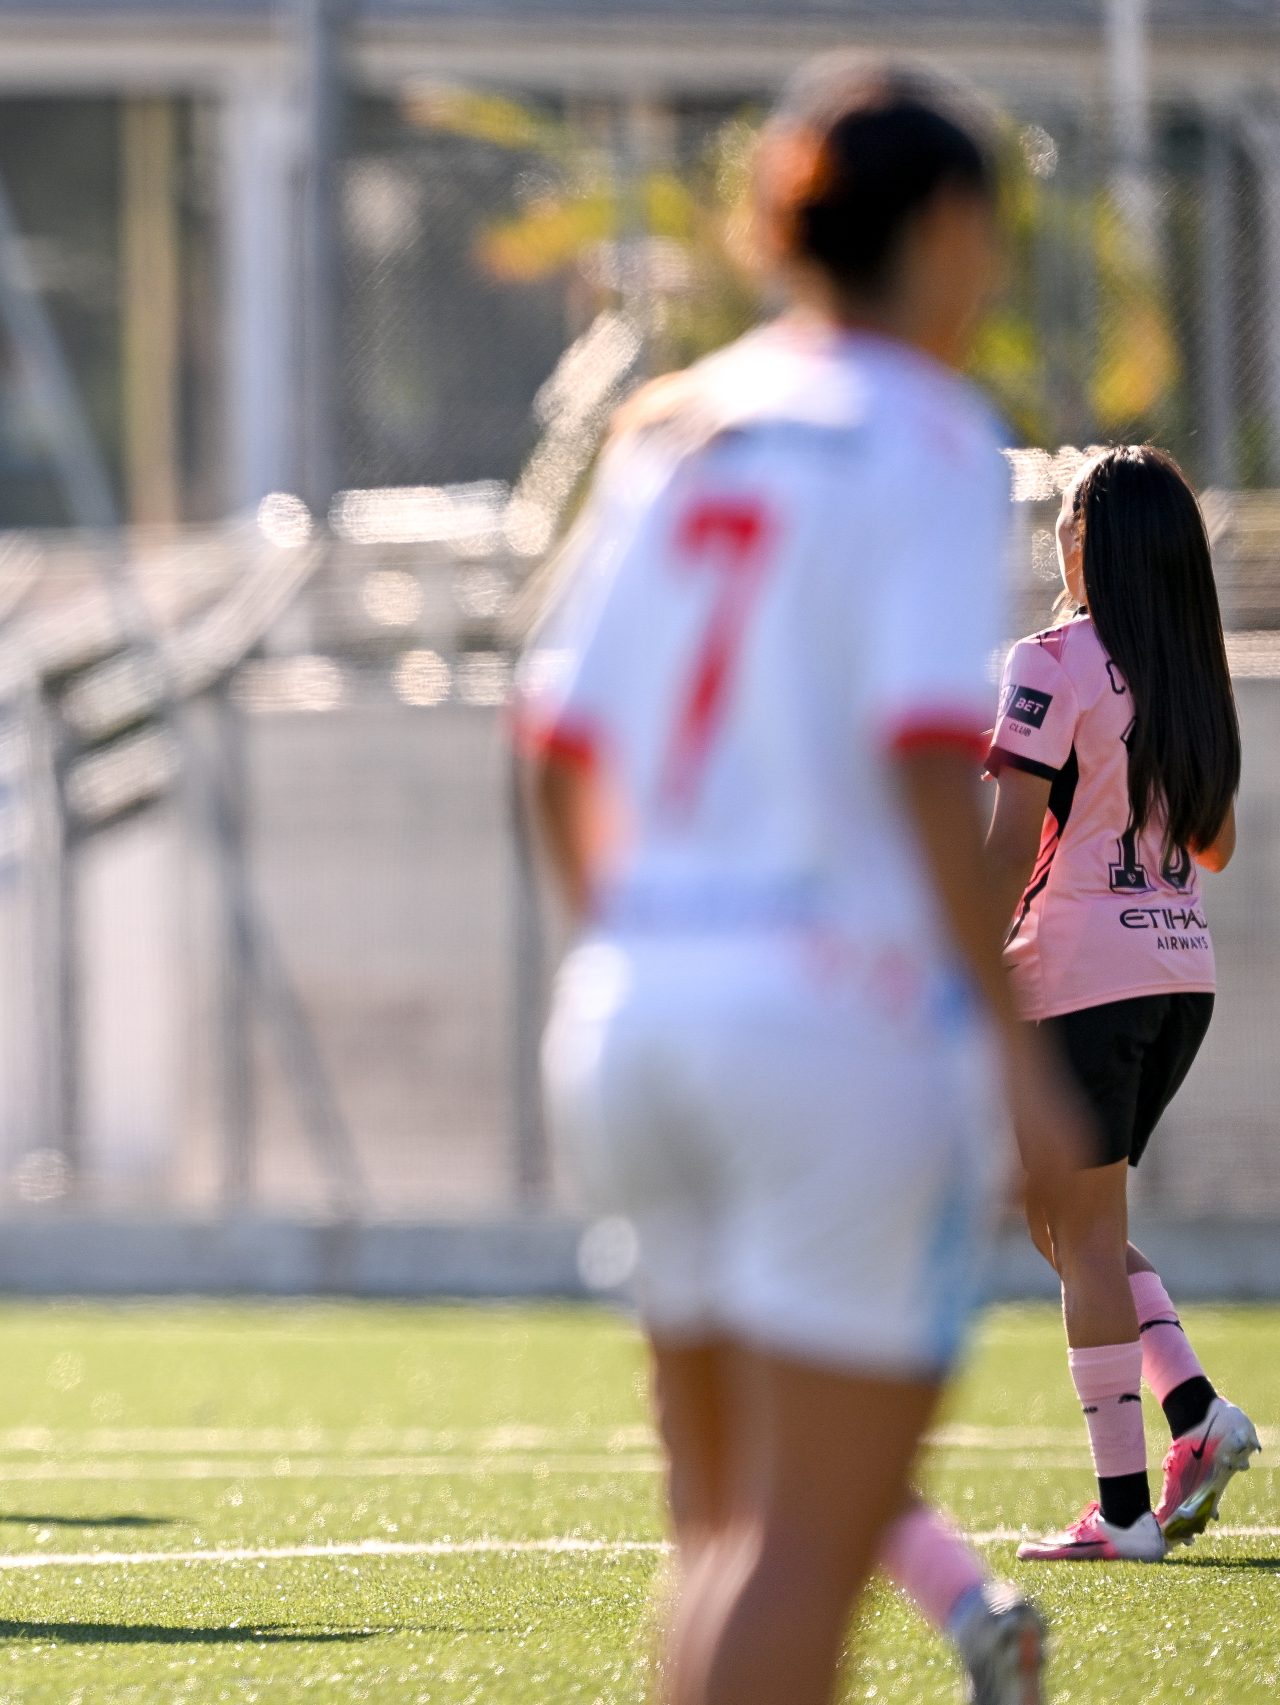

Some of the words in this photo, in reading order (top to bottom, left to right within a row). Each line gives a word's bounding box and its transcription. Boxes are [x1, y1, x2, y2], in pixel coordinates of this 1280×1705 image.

[665, 497, 775, 822] 7
[1015, 697, 1045, 715] BET
[1156, 936, 1209, 951] AIRWAYS
